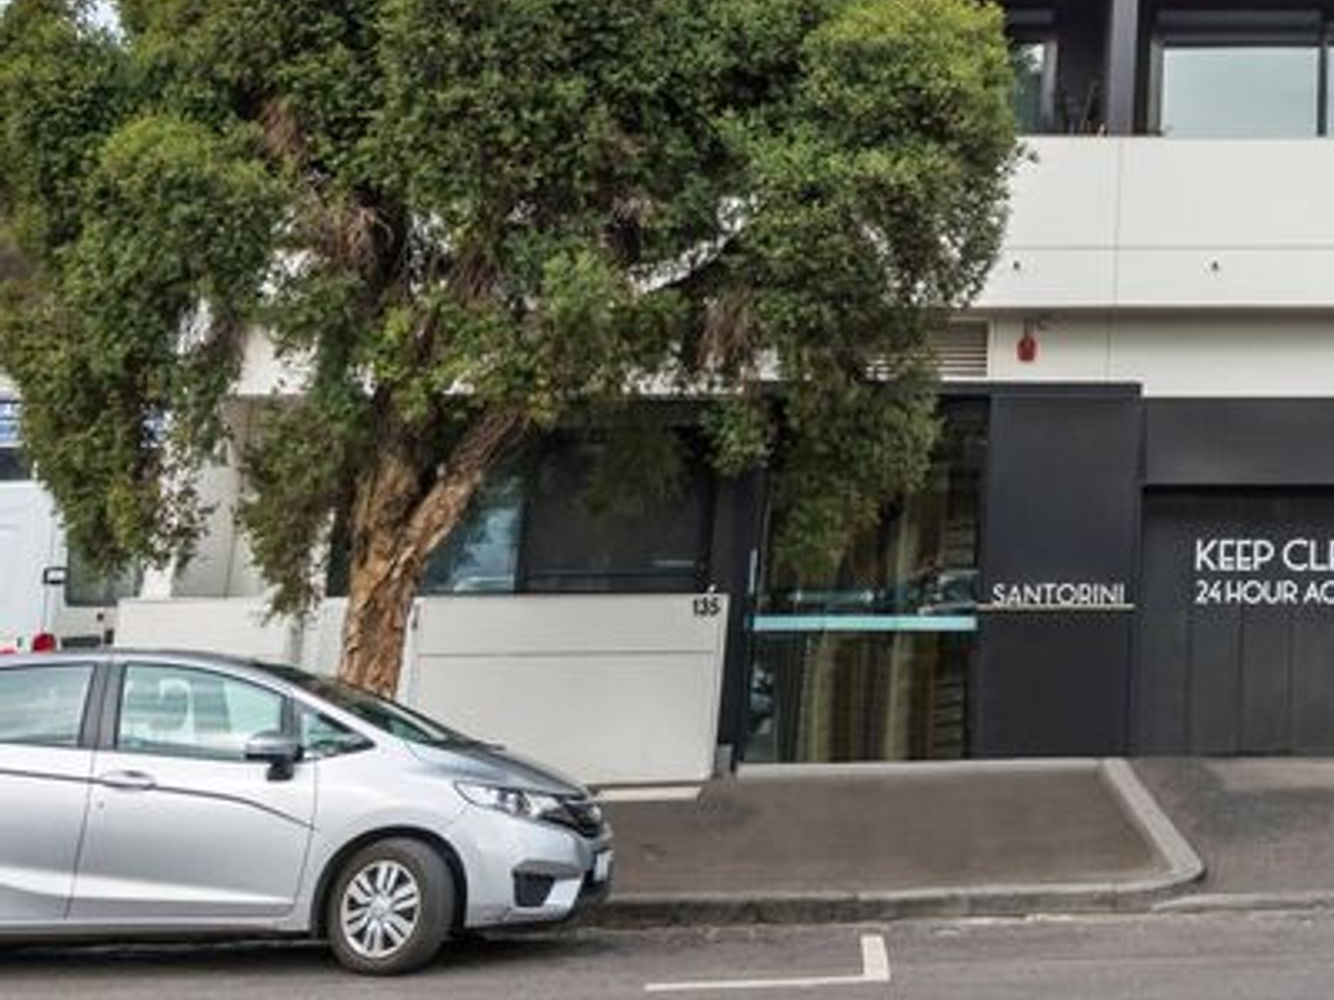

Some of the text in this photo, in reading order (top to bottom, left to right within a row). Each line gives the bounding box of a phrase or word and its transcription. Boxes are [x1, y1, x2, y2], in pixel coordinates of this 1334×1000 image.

[1195, 538, 1275, 571] KEEP
[992, 582, 1126, 606] SANTORINI
[1195, 579, 1222, 604] 24
[1225, 579, 1299, 604] HOUR
[692, 597, 721, 617] 135
